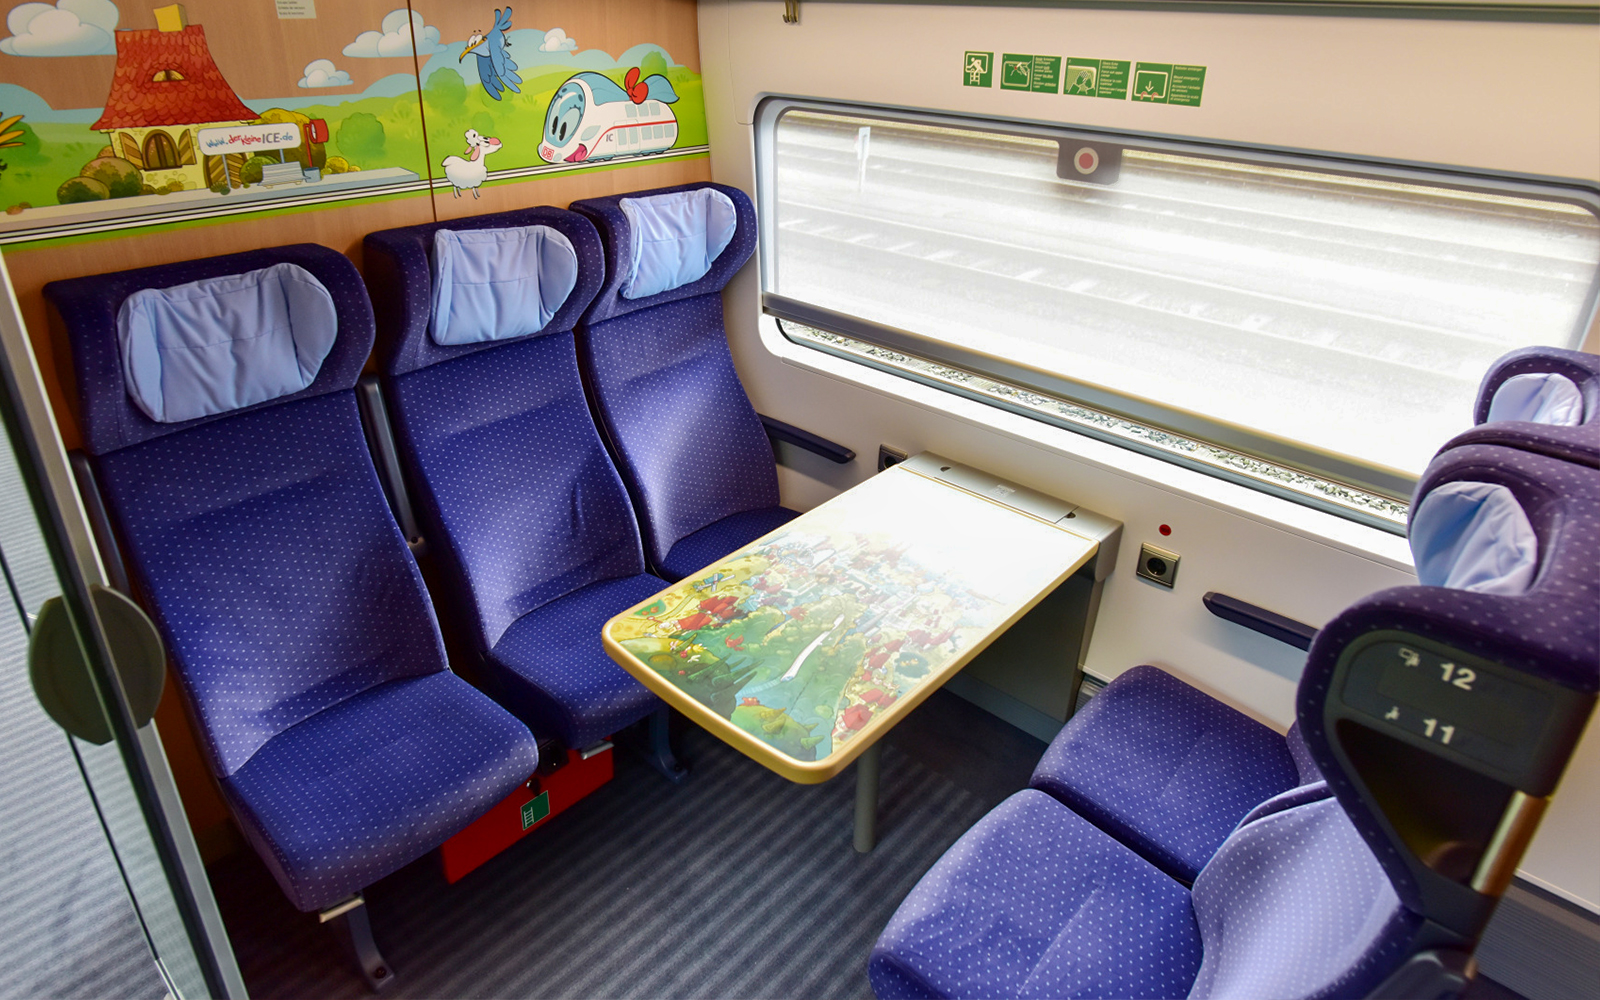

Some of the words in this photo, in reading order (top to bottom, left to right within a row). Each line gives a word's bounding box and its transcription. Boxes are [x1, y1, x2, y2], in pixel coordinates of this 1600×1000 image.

[605, 133, 614, 143] IC
[542, 146, 555, 161] DB
[1440, 662, 1477, 691] 12
[1423, 718, 1455, 745] 11
